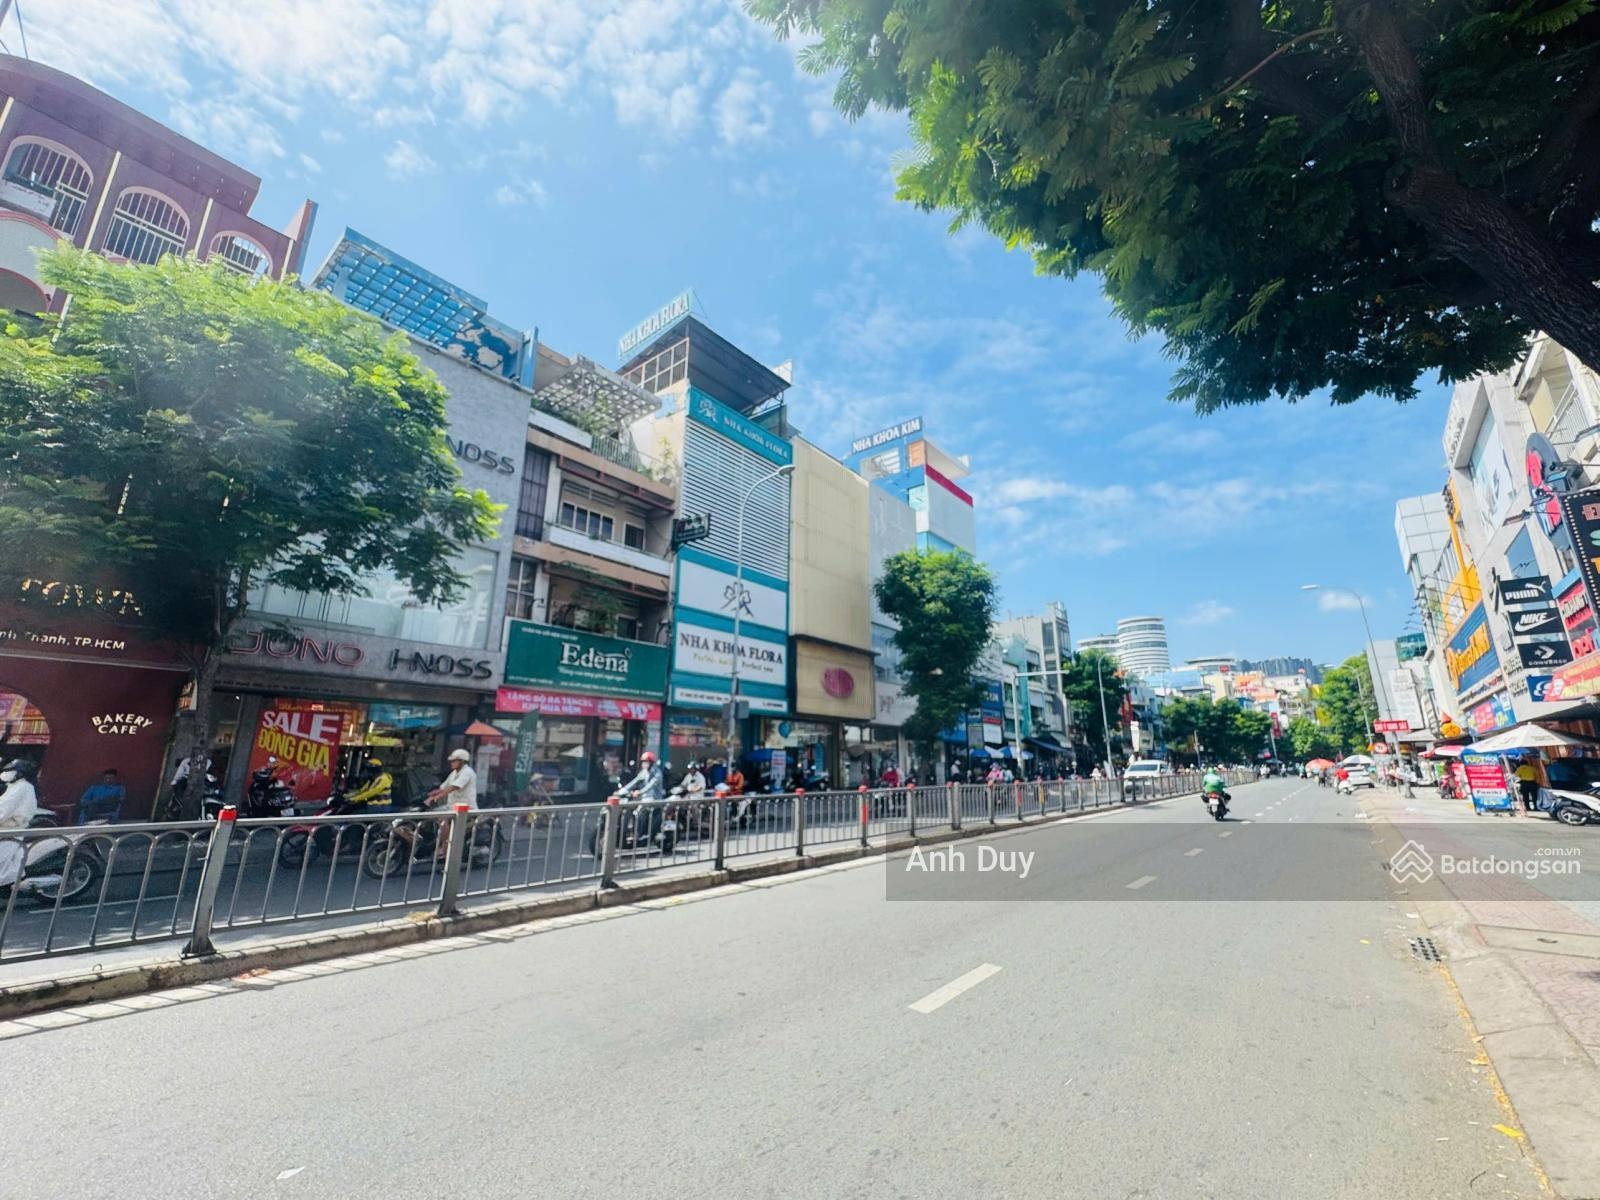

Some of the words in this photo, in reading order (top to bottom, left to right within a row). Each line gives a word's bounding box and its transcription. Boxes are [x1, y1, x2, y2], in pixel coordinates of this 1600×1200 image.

[852, 438, 872, 453] NHA
[873, 426, 900, 446] KHOA
[901, 418, 921, 435] KIM
[446, 434, 515, 475] NOSS
[1505, 589, 1540, 600] PUMA
[1520, 612, 1548, 624] NIKE
[73, 636, 126, 650] TP.HCM
[680, 632, 710, 651] NHA
[713, 639, 746, 658] KHOA
[749, 647, 783, 664] FLORA
[559, 642, 630, 673] Edena
[91, 713, 153, 728] BAKERY
[97, 725, 137, 735] CAFE
[262, 711, 340, 746] SALE
